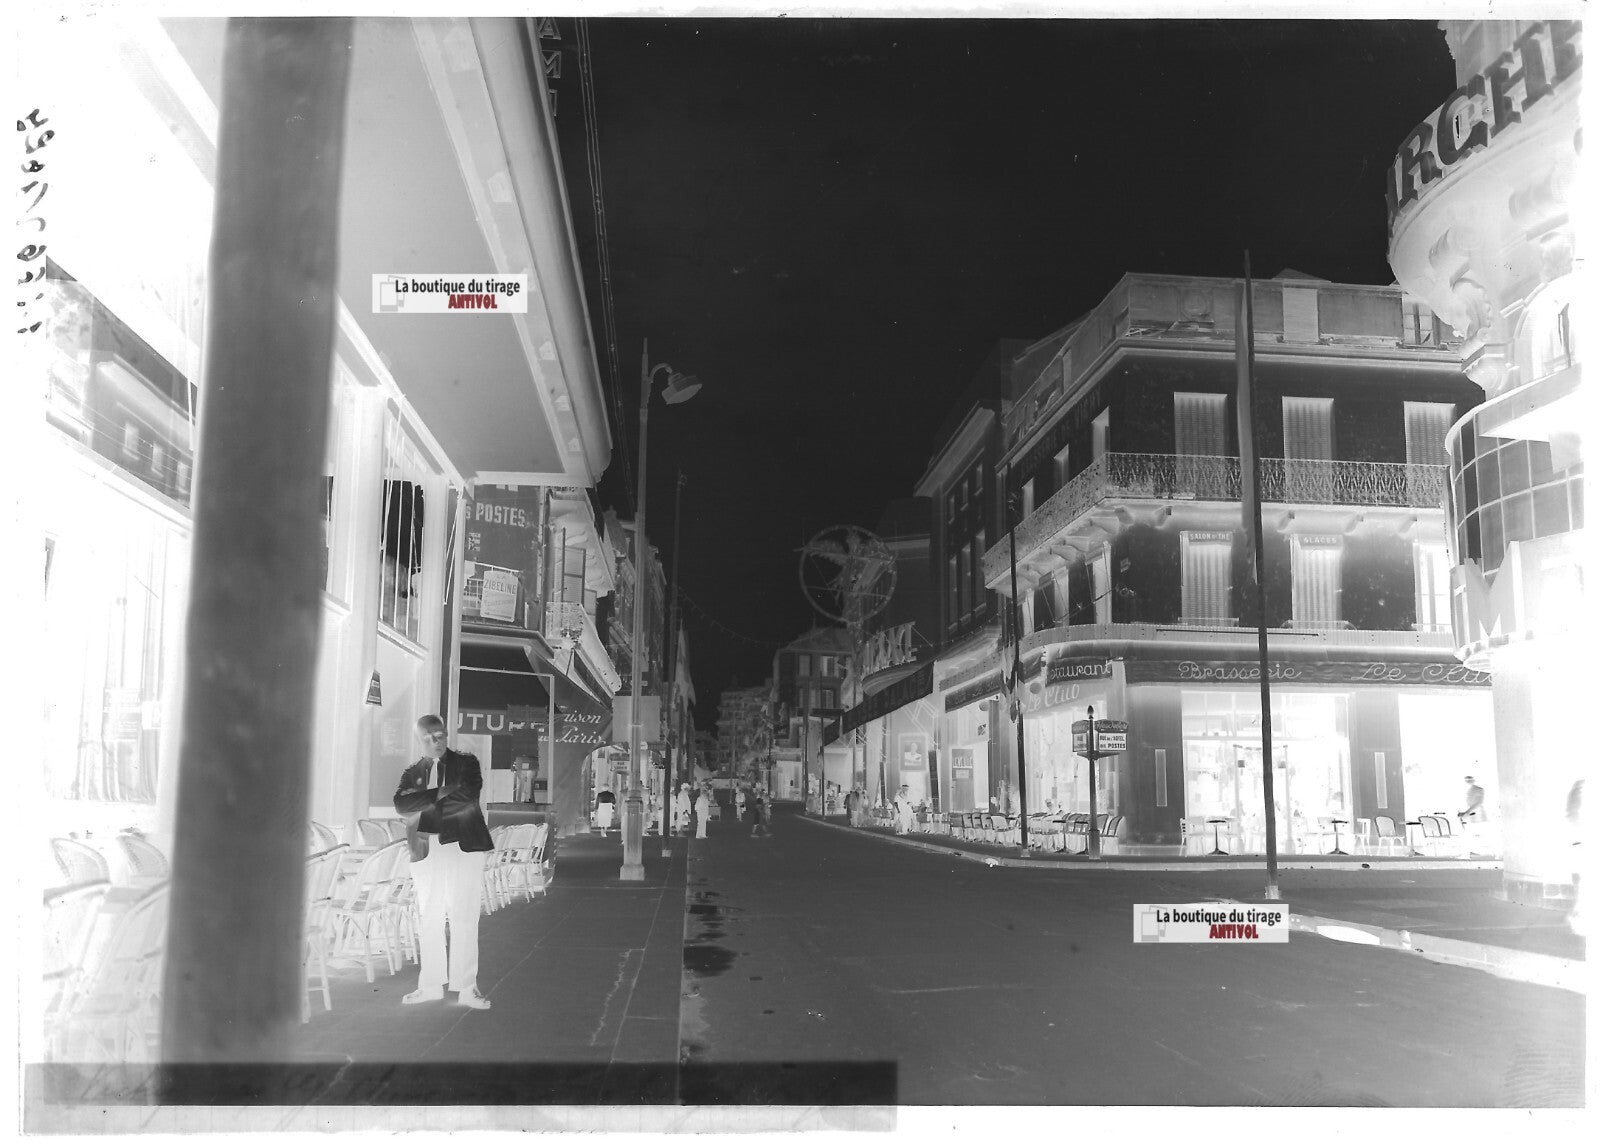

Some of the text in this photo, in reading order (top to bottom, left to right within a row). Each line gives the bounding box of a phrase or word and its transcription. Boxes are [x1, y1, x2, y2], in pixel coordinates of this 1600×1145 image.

[475, 502, 525, 528] POSTES
[1190, 533, 1211, 541] SALON
[1304, 536, 1337, 544] GLACES
[1178, 660, 1302, 681] Brasserie
[1351, 661, 1492, 684] Le Clu
